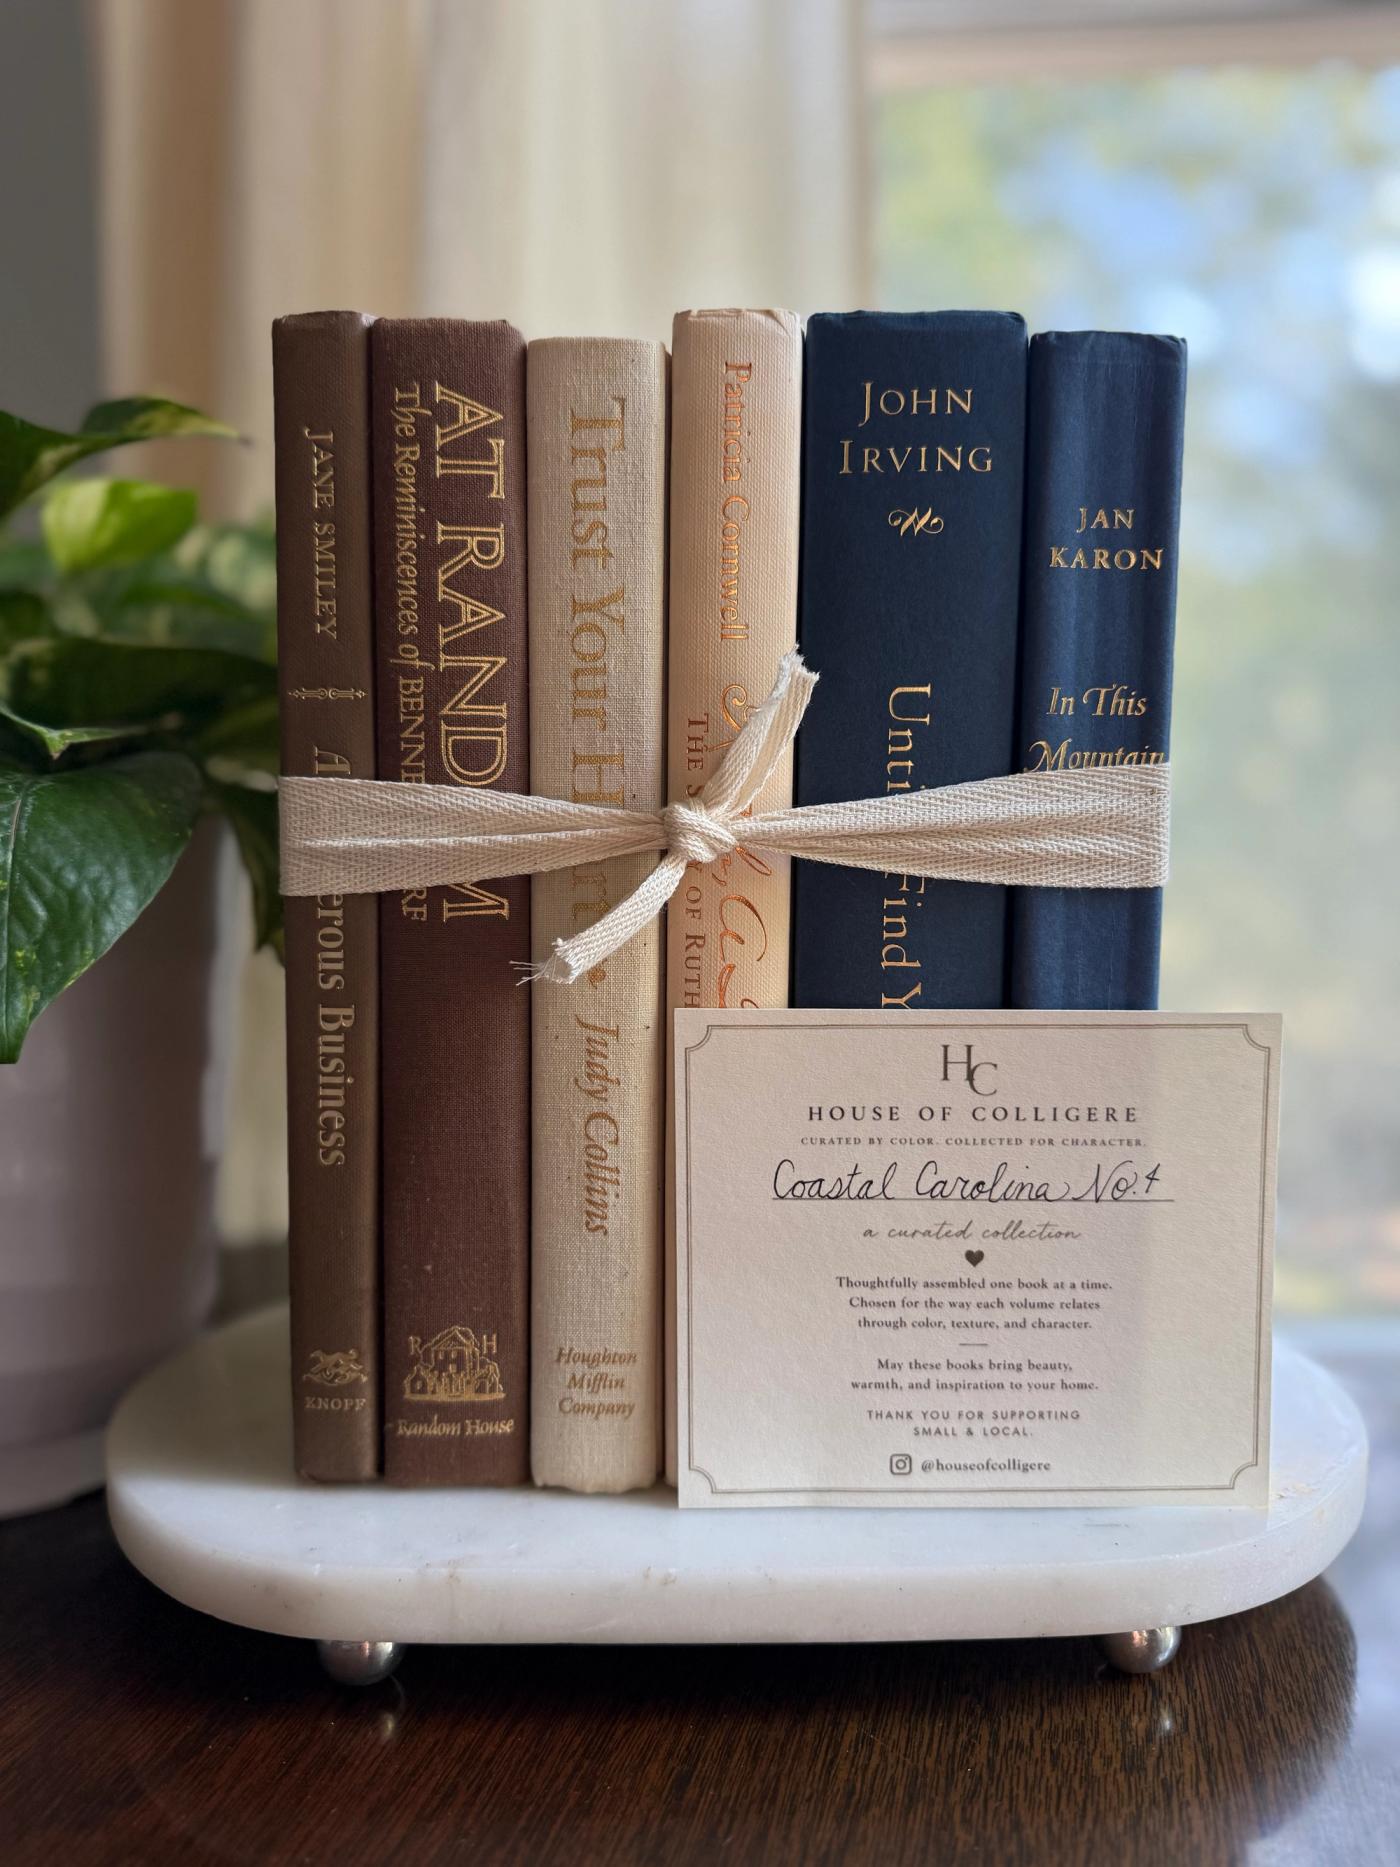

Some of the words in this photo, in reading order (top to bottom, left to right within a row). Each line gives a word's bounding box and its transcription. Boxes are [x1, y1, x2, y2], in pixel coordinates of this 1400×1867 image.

[390, 382, 432, 437] The
[858, 381, 973, 427] JOHN
[723, 360, 753, 484] Patricia
[435, 381, 505, 499] AT
[304, 426, 334, 509] JANE
[839, 440, 993, 475] IRVING
[569, 396, 625, 570] Trust
[1076, 507, 1136, 534] JAN
[394, 443, 426, 635] Reminiscences
[719, 496, 751, 643] Cornwell
[1049, 547, 1165, 571] KARON
[314, 522, 338, 640] SMILEY
[390, 643, 435, 671] of
[570, 588, 625, 731] Your
[1046, 687, 1075, 716] In
[1083, 684, 1148, 716] This
[399, 675, 426, 784] BENNE
[436, 520, 511, 923] RANDM
[886, 683, 932, 792] Unti
[687, 712, 709, 771] THE
[1024, 737, 1166, 773] Mountain
[313, 744, 351, 776] A
[401, 886, 428, 922] RF
[685, 886, 702, 920] OF
[575, 1014, 621, 1101] Judy
[318, 1004, 355, 1166] Business
[807, 1105, 901, 1122] HOUSE
[918, 1106, 953, 1122] OF
[971, 1106, 1137, 1123] COLLIGERE
[800, 1136, 862, 1147] CURATED
[868, 1137, 884, 1146] BY
[890, 1137, 940, 1147] COLOR.
[945, 1137, 1024, 1147] COLLECTED
[1030, 1137, 1055, 1147] FOR
[1061, 1137, 1147, 1148] CHARACTER.
[584, 1110, 621, 1236] Collins
[773, 1159, 897, 1201] Coastal
[916, 1161, 1071, 1204] Carolina
[862, 1228, 880, 1240] a
[887, 1219, 974, 1241] curated
[981, 1220, 1082, 1242] collection
[835, 1276, 918, 1292] Thoughtfully
[922, 1277, 986, 1291] assembled
[989, 1280, 1013, 1290] one
[1017, 1277, 1048, 1291] book
[1052, 1280, 1066, 1291] at
[1069, 1281, 1077, 1291] a
[1080, 1278, 1113, 1291] time.
[848, 1296, 897, 1310] Chosen
[901, 1296, 920, 1309] for
[924, 1296, 945, 1310] the
[948, 1300, 973, 1312] way
[976, 1297, 1005, 1310] each
[1009, 1297, 1056, 1311] volume
[1059, 1297, 1101, 1311] relates
[857, 1316, 908, 1332] through
[911, 1316, 947, 1331] color,
[951, 1318, 1000, 1331] texture,
[1003, 1317, 1028, 1330] and
[1031, 1316, 1093, 1330] character.
[408, 1336, 422, 1354] R
[482, 1333, 498, 1354] H
[556, 1347, 638, 1367] Houghton
[876, 1358, 904, 1373] May
[908, 1358, 942, 1371] these
[946, 1358, 985, 1371] books
[988, 1358, 1024, 1373] bring
[1027, 1358, 1073, 1373] beauty,
[566, 1373, 626, 1395] Mifflin
[850, 1377, 904, 1392] warmth,
[907, 1377, 932, 1391] and
[935, 1378, 1006, 1393] inspiration
[1009, 1379, 1023, 1391] to
[1026, 1381, 1056, 1393] your
[1060, 1377, 1099, 1391] home.
[304, 1396, 367, 1411] KNOPF
[558, 1396, 636, 1420] Company
[866, 1409, 914, 1421] THANK
[920, 1409, 951, 1421] YOU
[957, 1409, 985, 1421] FOR
[991, 1409, 1081, 1421] SUPPORTING
[397, 1414, 462, 1437] Random
[465, 1417, 515, 1436] House
[912, 1426, 958, 1438] SMALL
[965, 1426, 975, 1437] &
[982, 1426, 1034, 1438] LOCAL.
[921, 1457, 1051, 1475] @houseofcolligere
